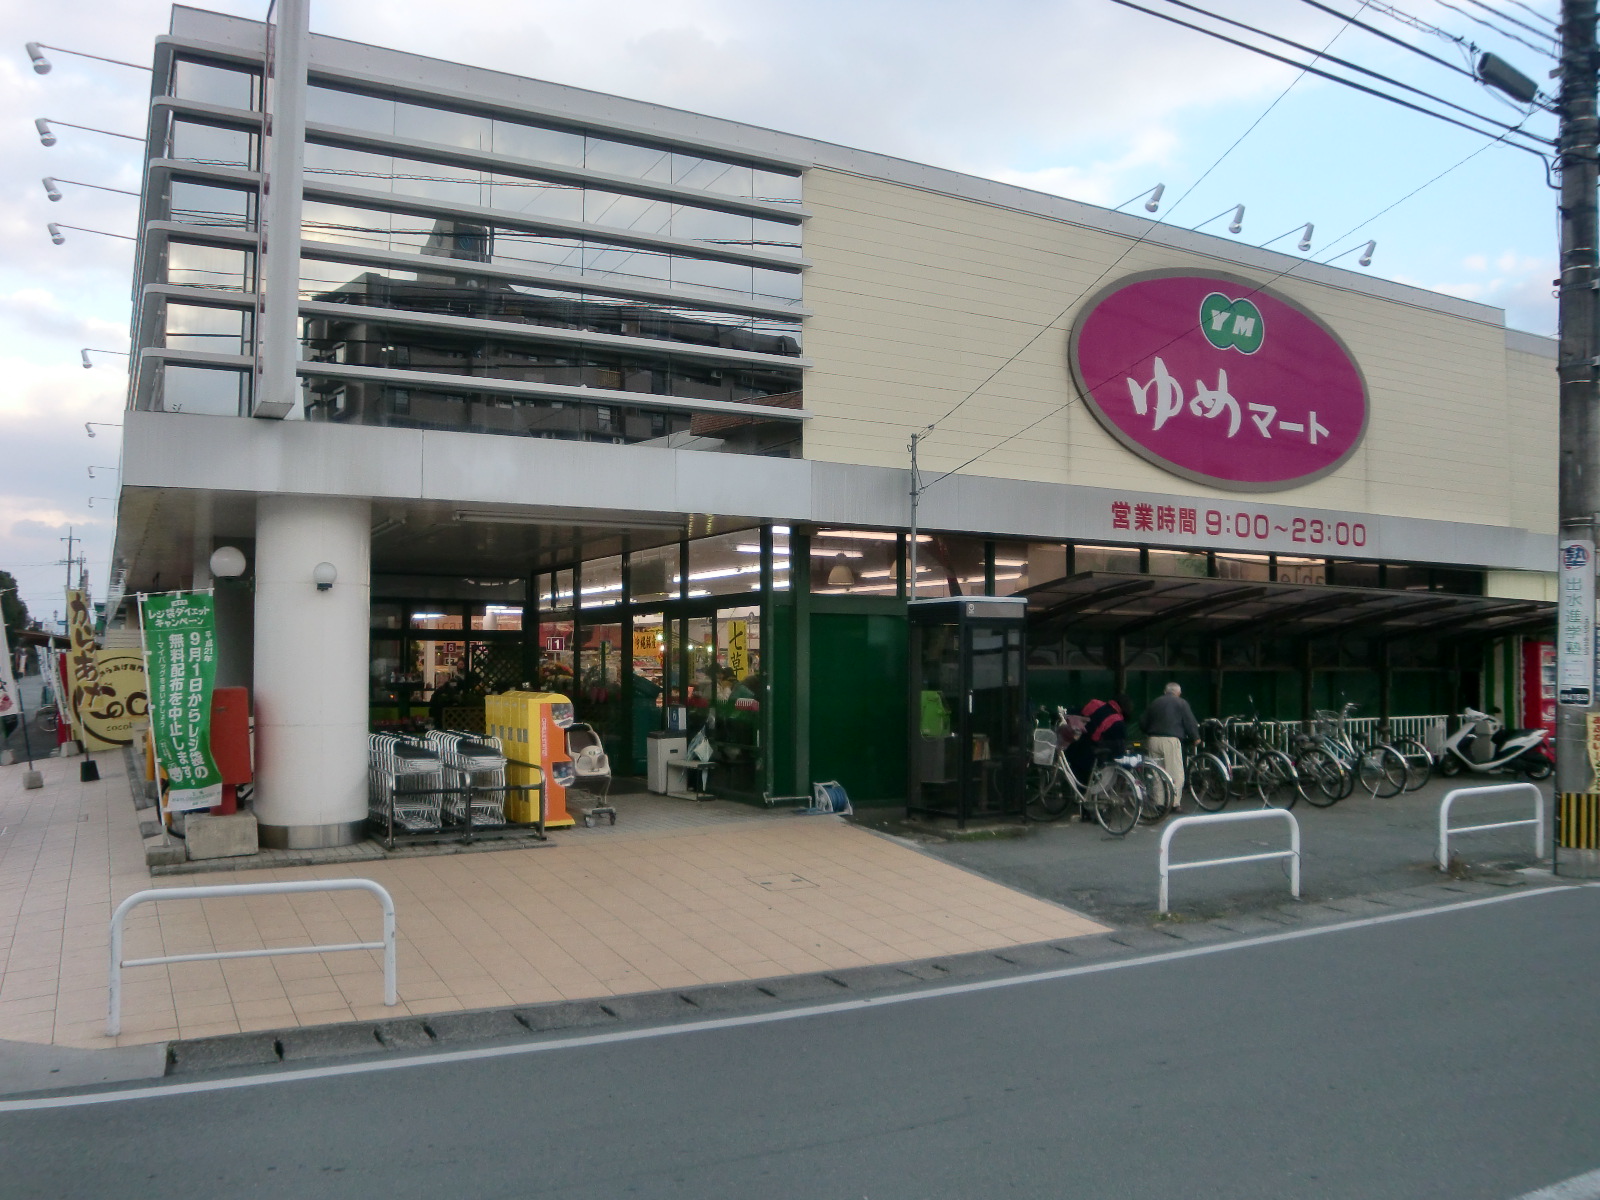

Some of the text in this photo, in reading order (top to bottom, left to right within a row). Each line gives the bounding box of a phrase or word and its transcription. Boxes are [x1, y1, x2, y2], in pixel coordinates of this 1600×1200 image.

[1210, 309, 1256, 337] YM
[1126, 356, 1330, 445] ゆめマート
[1111, 501, 1197, 535] 営業時間
[148, 606, 210, 619] レジ袋ダイエット
[155, 617, 204, 627] キャンペーン
[1565, 577, 1582, 655] 出水進学塾
[71, 592, 105, 708] からあげ
[99, 664, 149, 678] からあげ専門
[729, 622, 744, 677] 七草
[188, 632, 209, 778] 9月1日からレジ袋の
